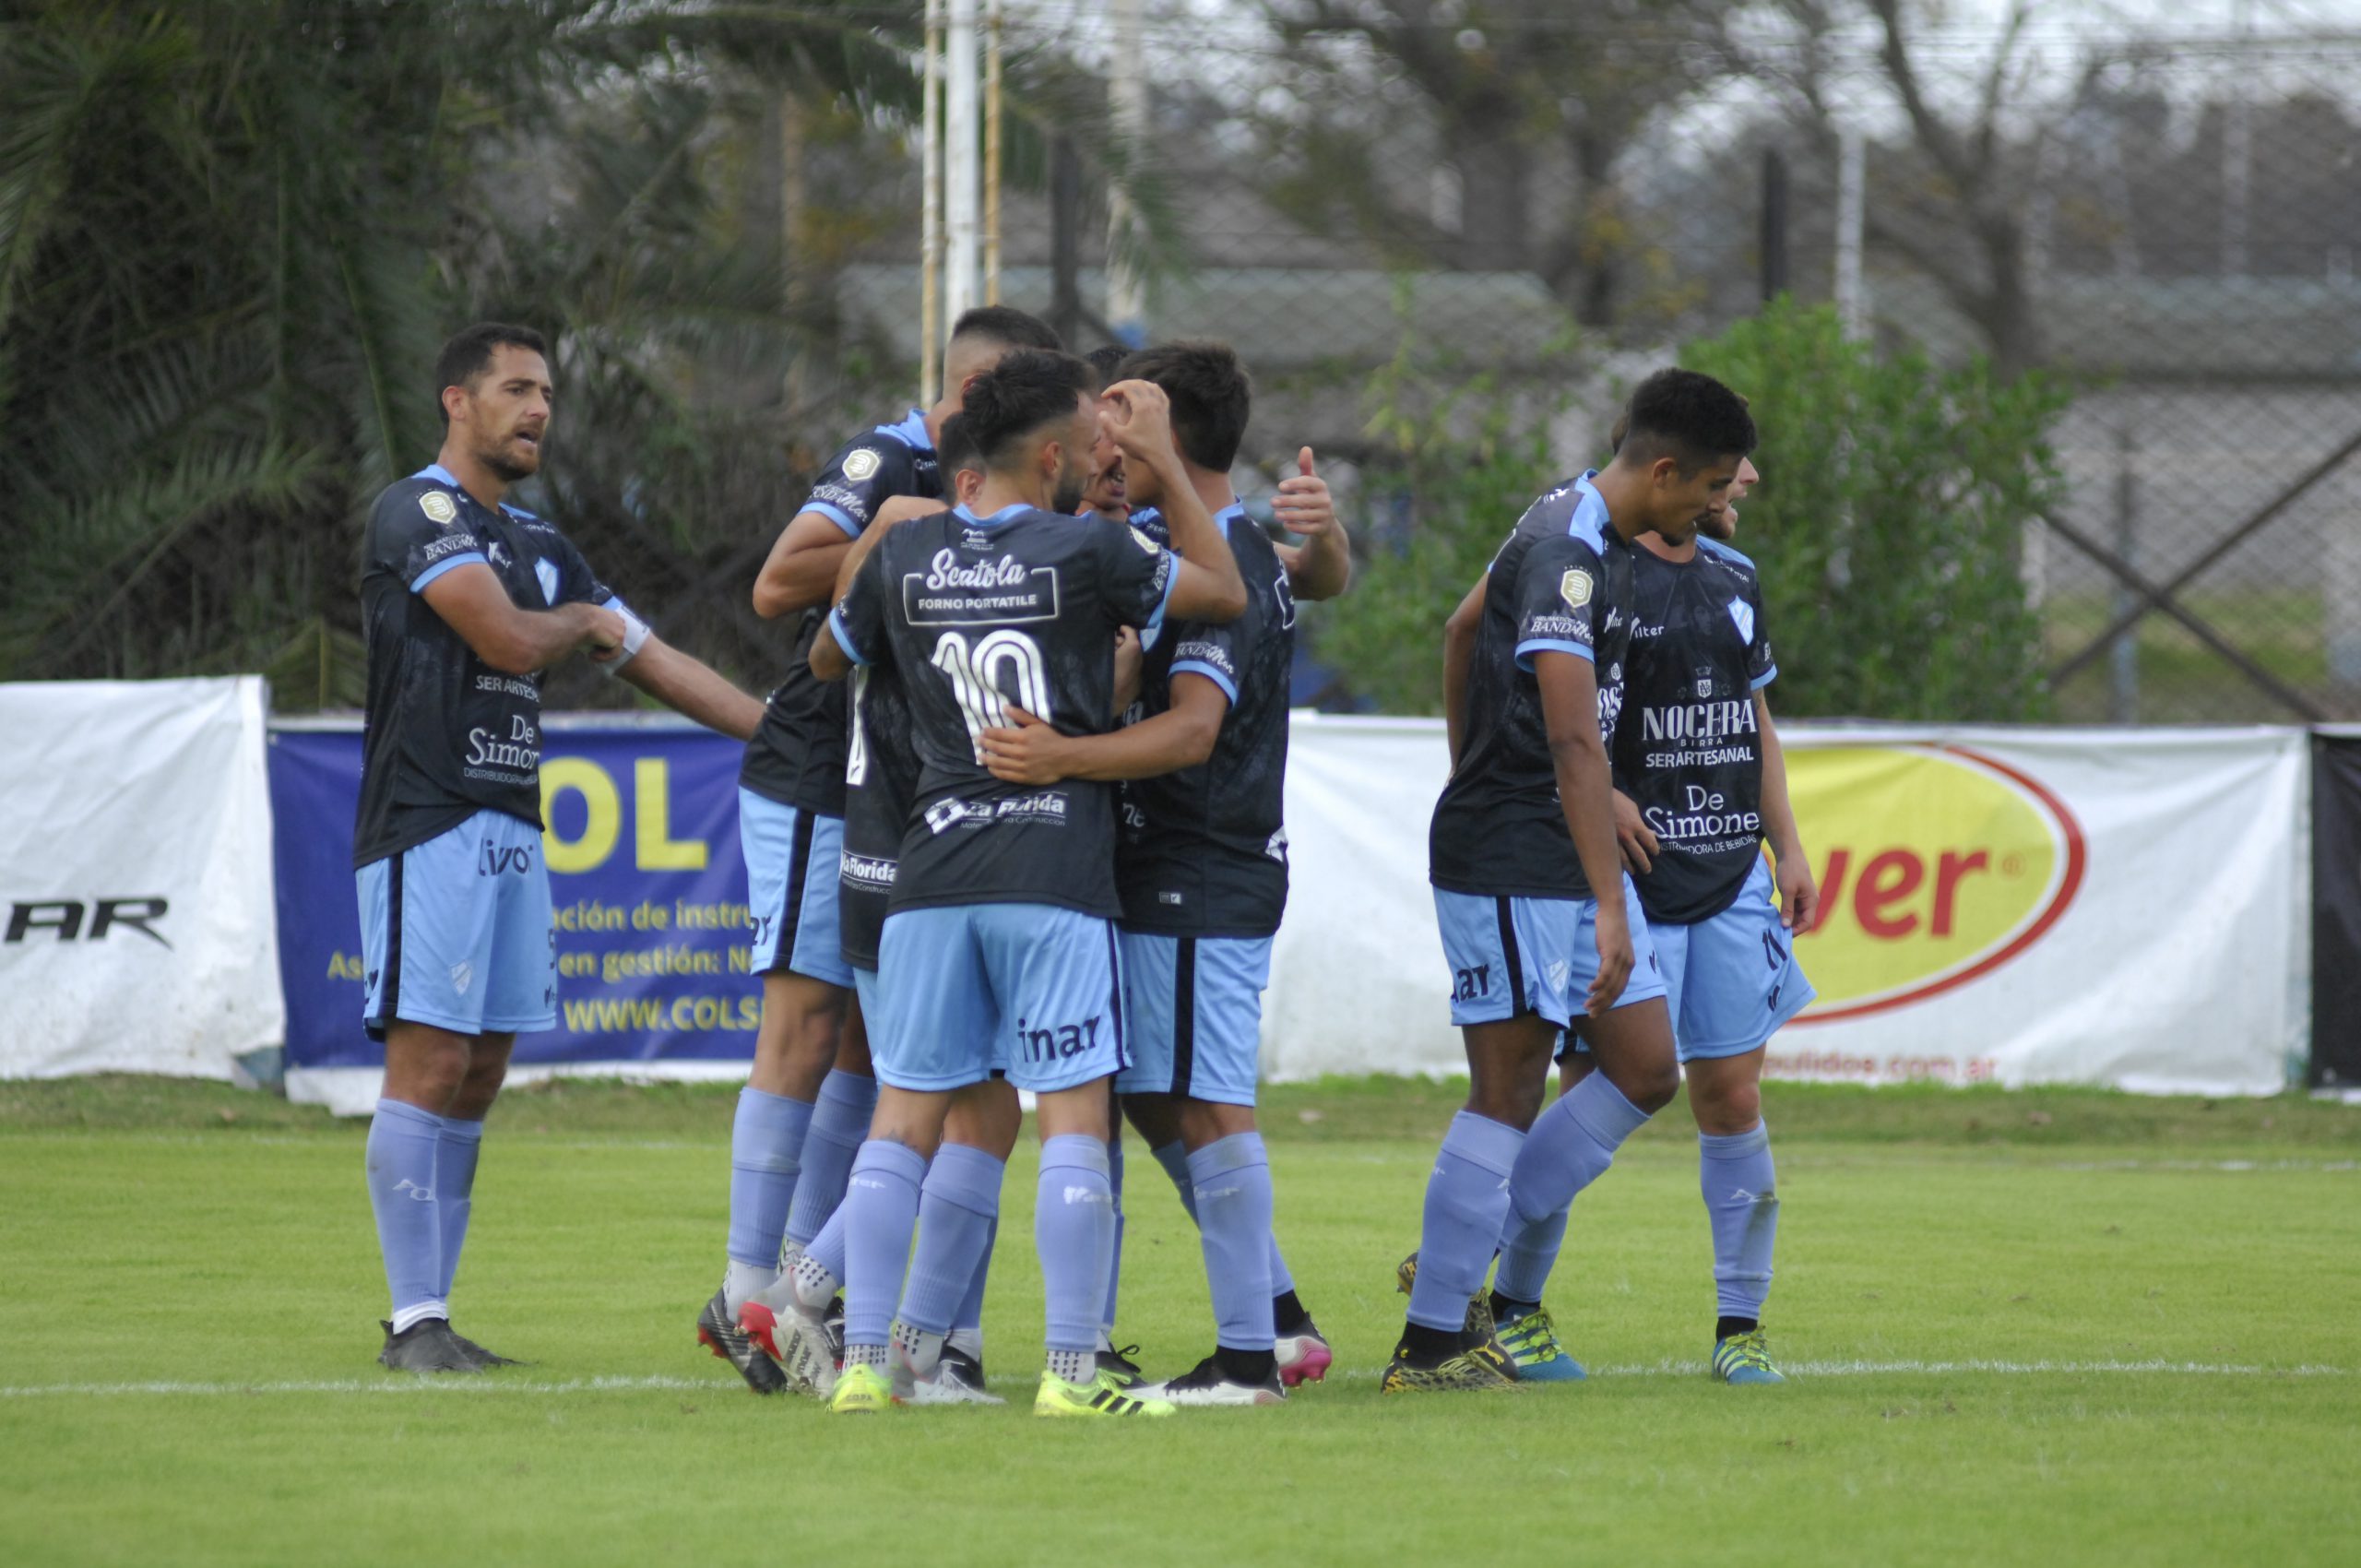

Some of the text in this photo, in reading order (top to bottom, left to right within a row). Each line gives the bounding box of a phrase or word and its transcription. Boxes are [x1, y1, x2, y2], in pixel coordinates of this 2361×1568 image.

[926, 548, 1026, 590] Scatola
[919, 594, 1037, 610] FORNO PORTATILE
[475, 674, 503, 692] SER
[931, 629, 1052, 766] 10
[510, 715, 535, 744] De
[1642, 698, 1758, 741] NOCERA
[1680, 737, 1723, 747] BIRRA
[1686, 785, 1724, 812] De
[1645, 806, 1760, 840] Simone
[1715, 843, 1726, 852] DE
[1726, 834, 1757, 850] BEBIDAS
[631, 898, 668, 931] de
[558, 951, 597, 979] en
[1017, 1015, 1100, 1063] inar
